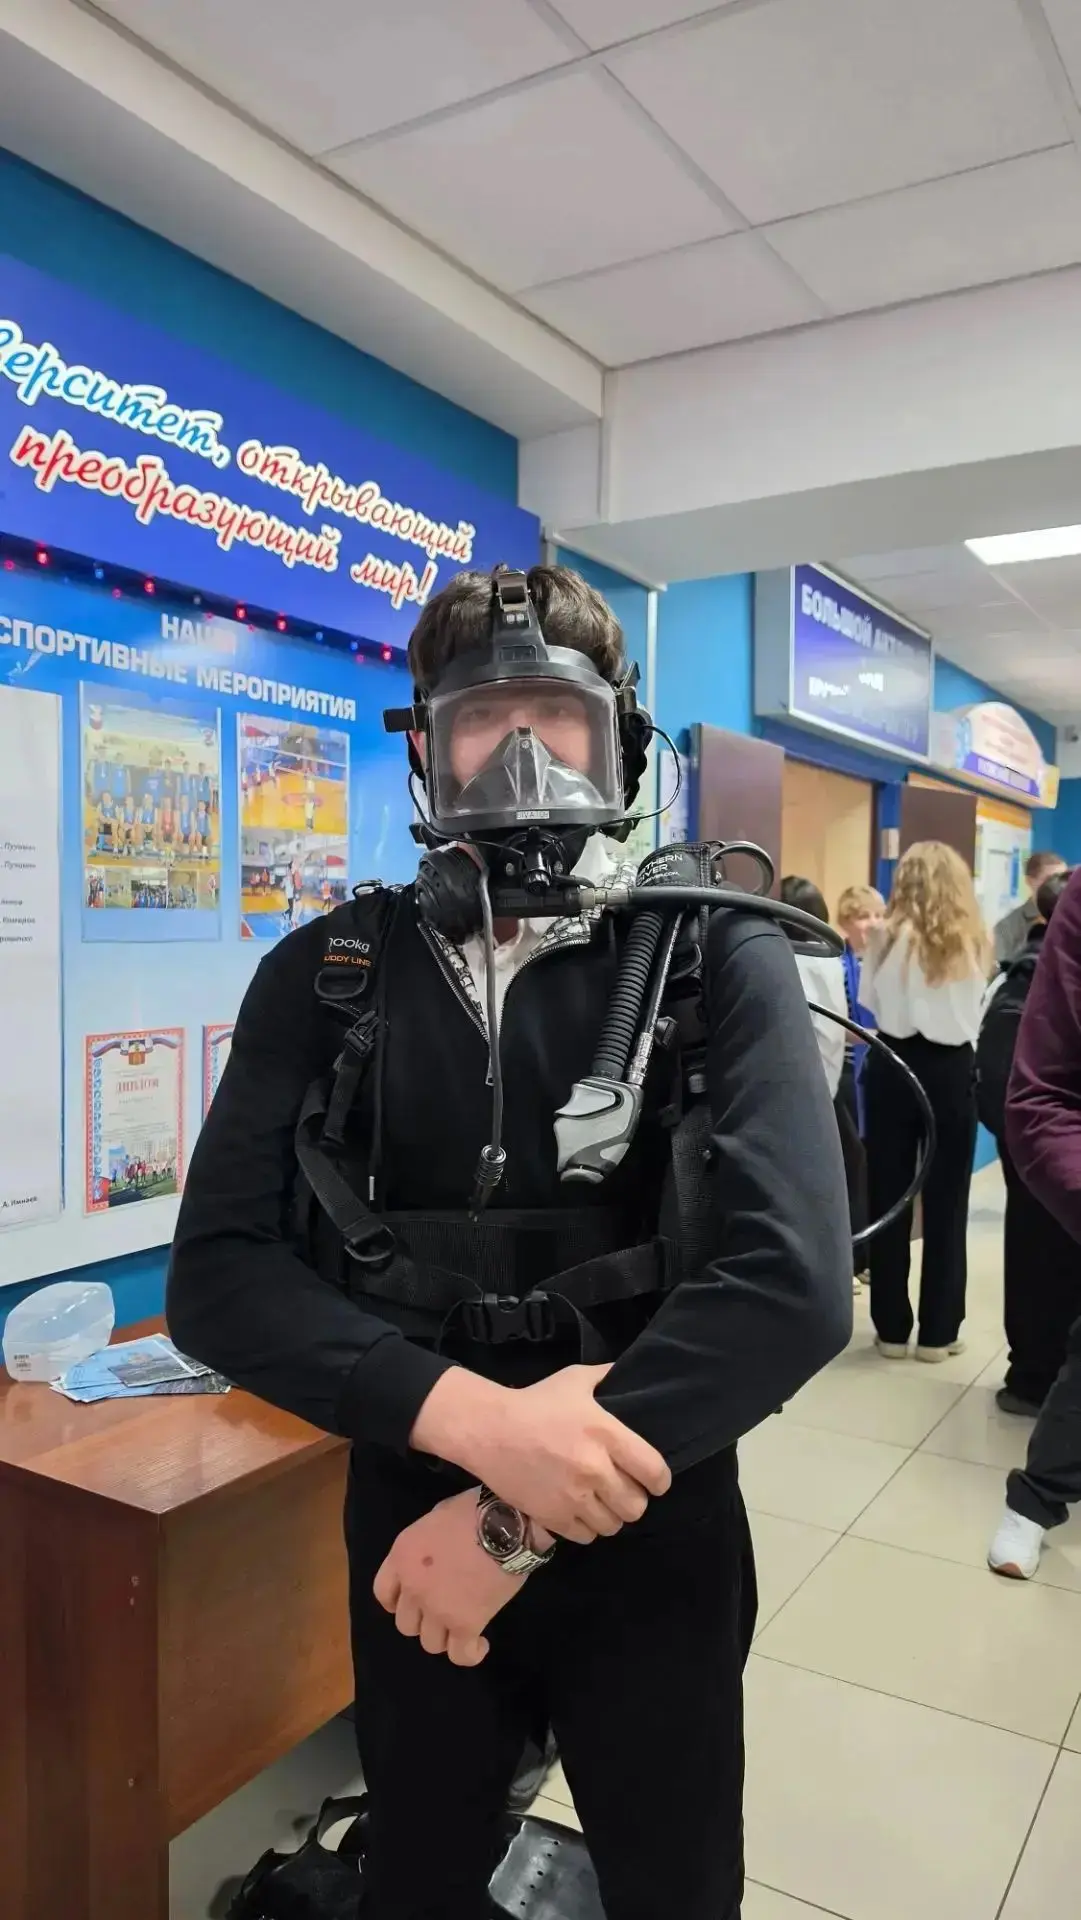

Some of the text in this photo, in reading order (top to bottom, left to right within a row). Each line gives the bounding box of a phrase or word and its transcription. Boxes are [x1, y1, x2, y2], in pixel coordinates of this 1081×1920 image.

[12, 428, 437, 607] преобразующий мир!
[238, 441, 475, 562] открывающий
[0, 615, 356, 722] СПОРТИВНЫЕ МЕРОПРИЯТИЯ
[161, 613, 237, 656] НАШ
[802, 584, 872, 648] БОЛЬШОЙ
